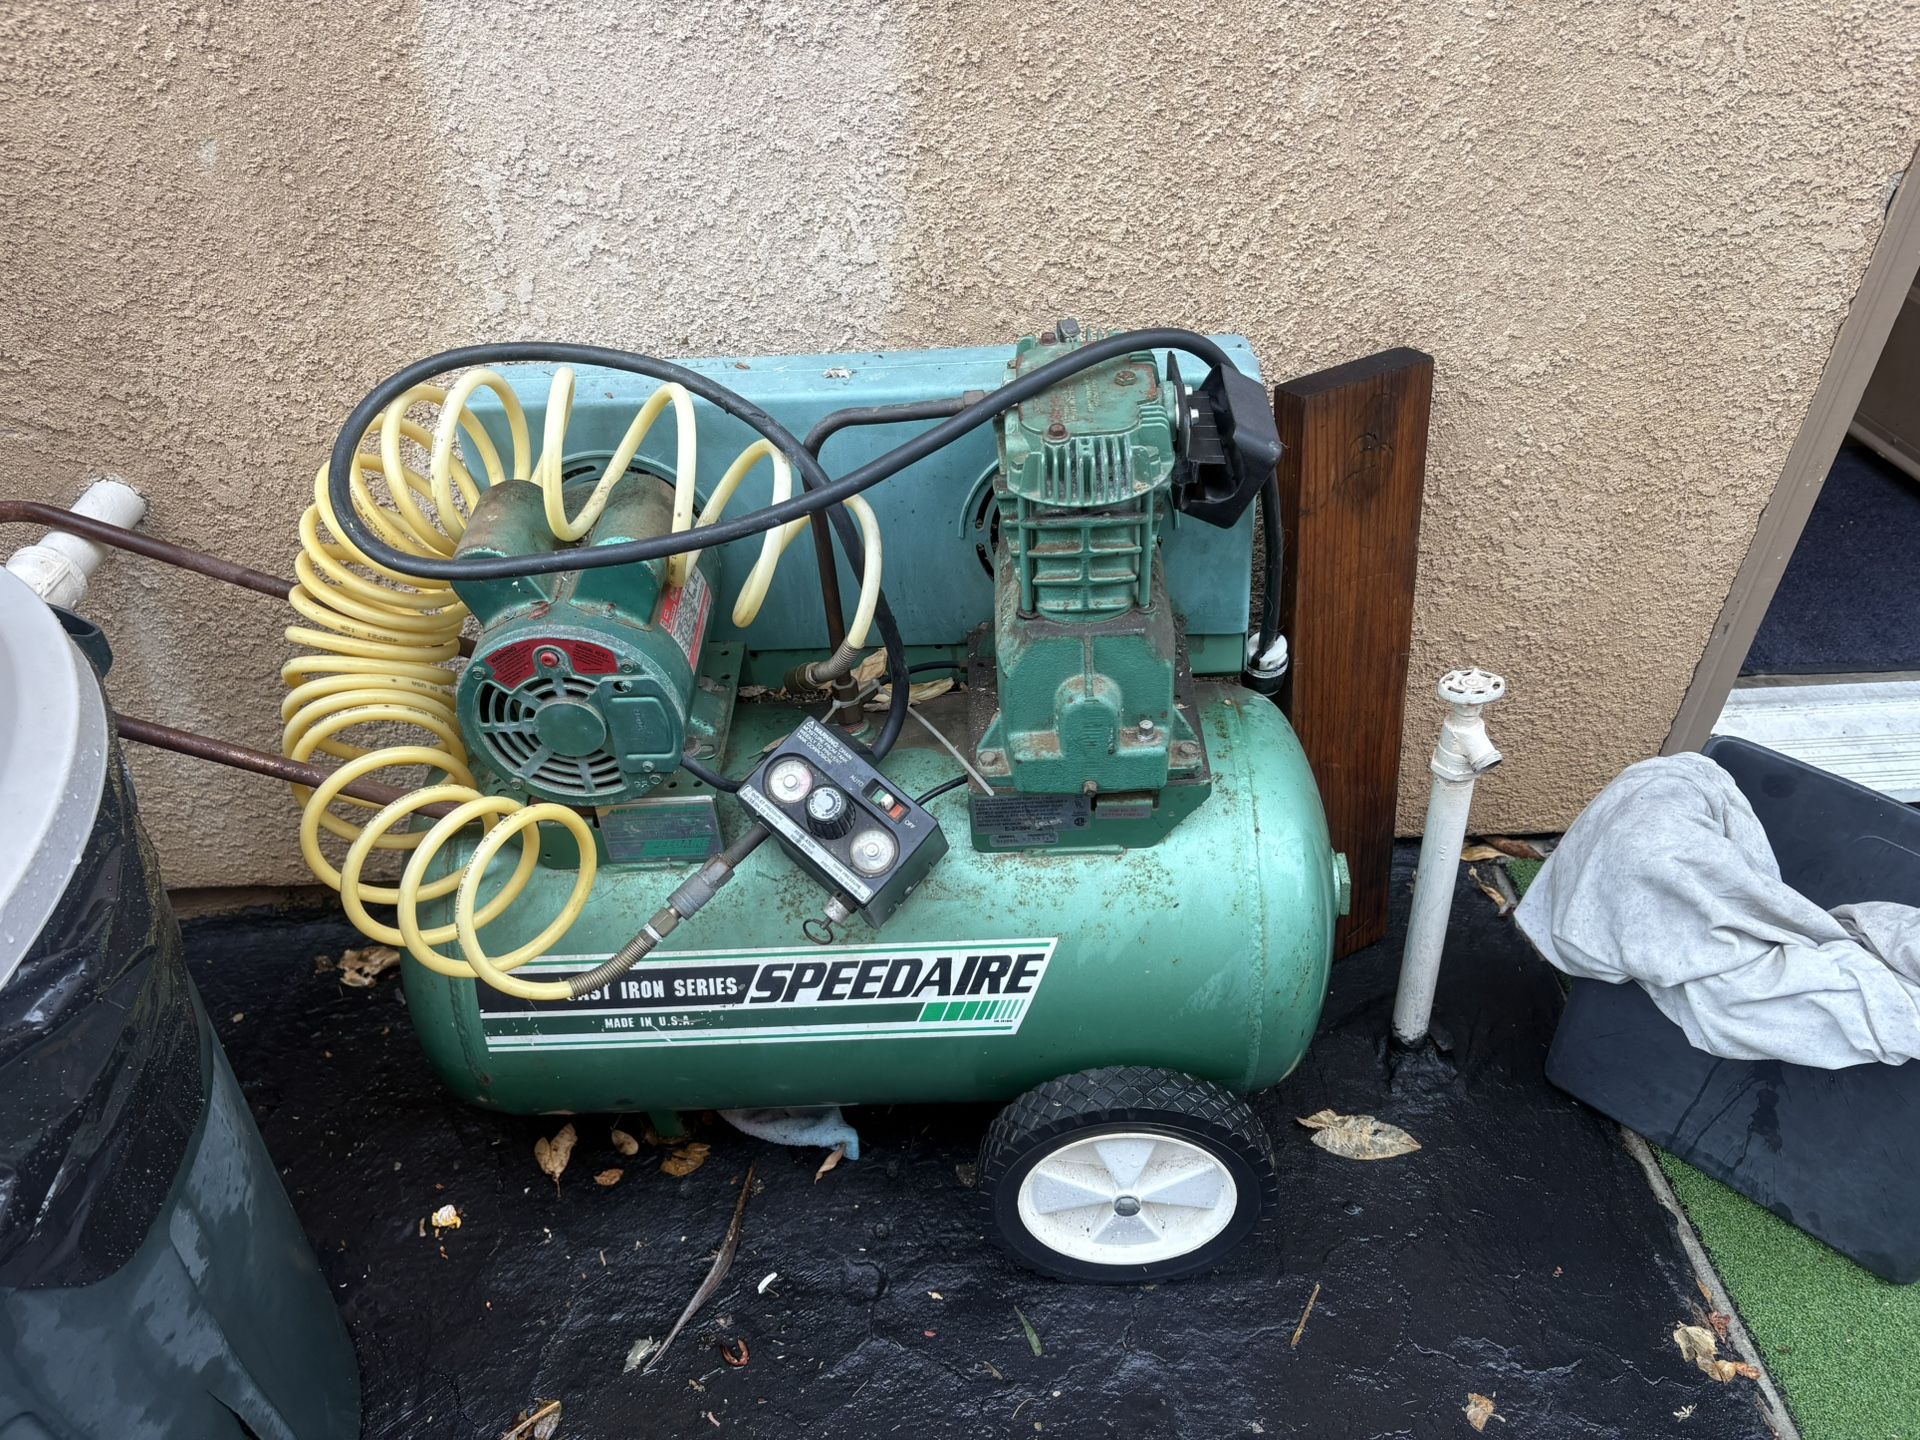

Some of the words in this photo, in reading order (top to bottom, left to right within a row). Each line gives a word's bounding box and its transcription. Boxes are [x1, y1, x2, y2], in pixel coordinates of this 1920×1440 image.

[849, 774, 865, 788] AUTO
[904, 819, 916, 829] OFF
[749, 953, 1046, 1004] SPEEDAIRE
[620, 980, 665, 1000] IRON
[674, 977, 738, 997] SERIES
[604, 1017, 635, 1029] MADE
[640, 1016, 653, 1028] IN
[659, 1015, 695, 1027] U.S.A.
